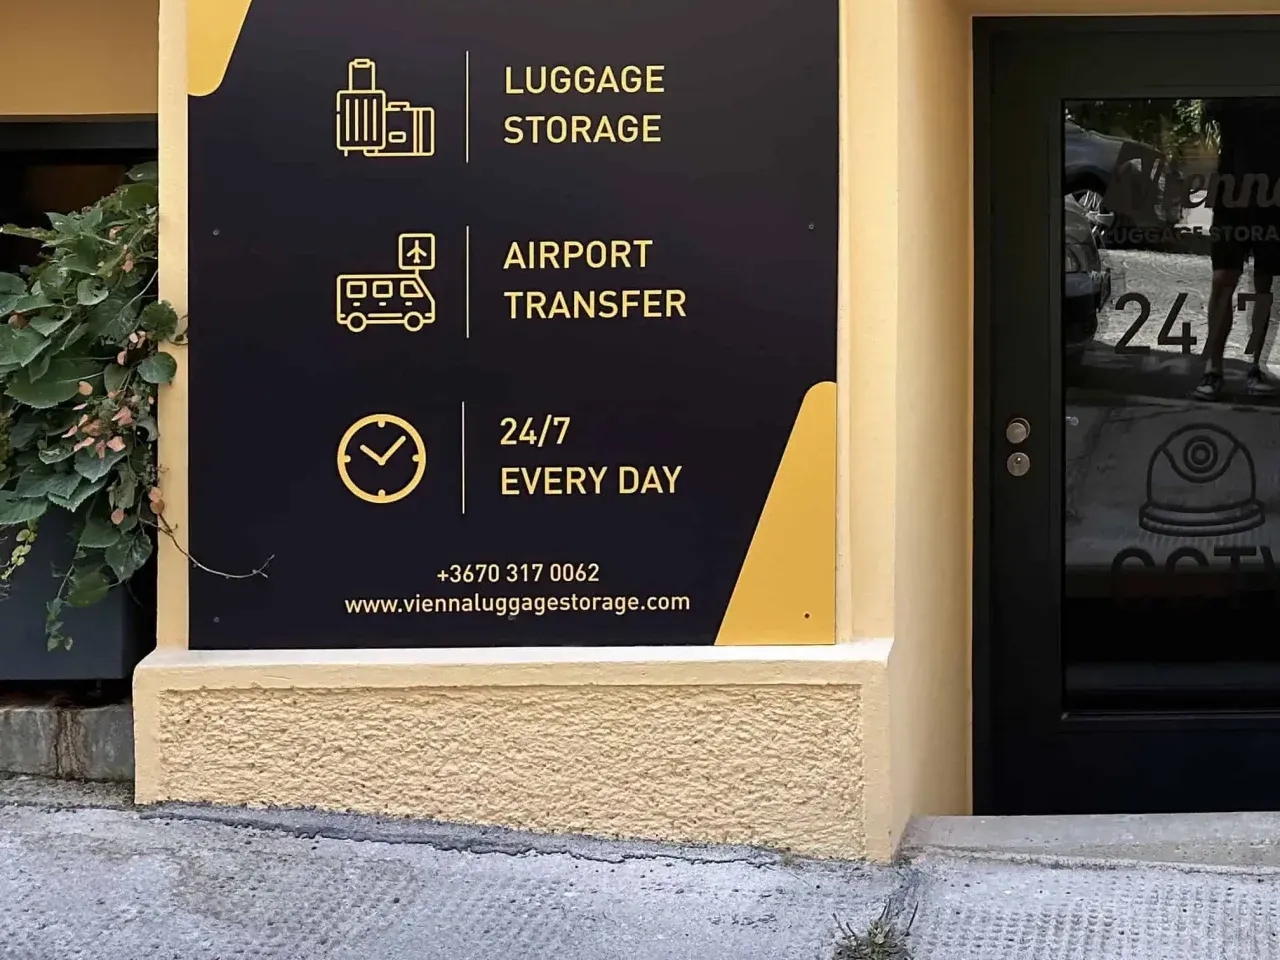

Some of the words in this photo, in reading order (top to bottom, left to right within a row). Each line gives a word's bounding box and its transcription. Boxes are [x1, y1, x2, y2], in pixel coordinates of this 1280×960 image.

[504, 65, 665, 95] LUGGAGE
[503, 114, 662, 144] STORAGE
[503, 239, 654, 270] AIRPORT
[503, 289, 687, 320] TRANSFER
[1114, 291, 1274, 355] 247
[499, 414, 571, 448] 24/7
[501, 466, 608, 495] EVERY
[618, 465, 683, 494] DAY
[436, 563, 501, 583] +3670
[506, 563, 544, 583] 317
[550, 562, 600, 582] 0062
[344, 592, 690, 616] www.viennaluggagestorage.com
